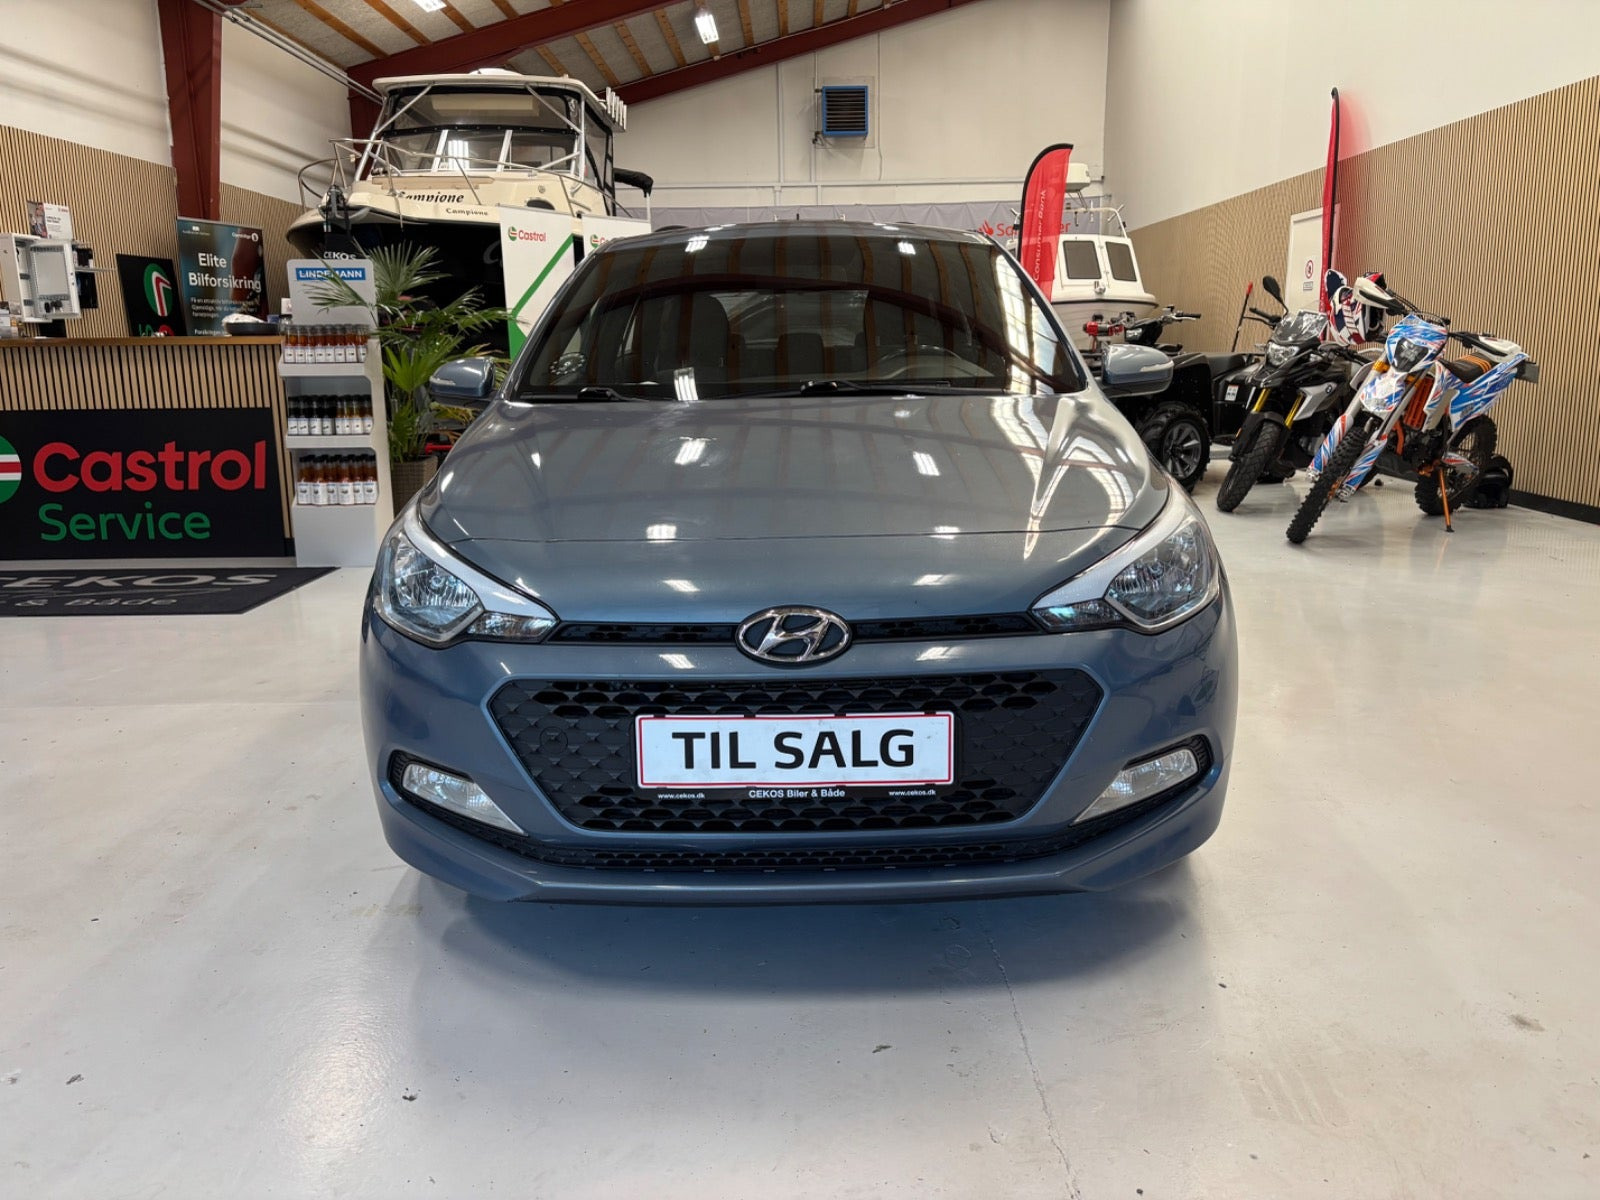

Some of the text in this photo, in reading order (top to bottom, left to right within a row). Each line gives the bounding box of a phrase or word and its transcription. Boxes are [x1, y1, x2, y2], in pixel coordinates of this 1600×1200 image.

[518, 229, 546, 242] Castrol
[198, 252, 227, 268] Elite
[1033, 222, 1043, 281] Consumer
[188, 272, 261, 293] Bilforsikring
[33, 440, 266, 492] Castrol
[39, 501, 211, 541] Service
[0, 574, 277, 588] EKOS
[672, 729, 914, 769] TIL SALG
[748, 788, 845, 798] CEKOS Biler & Både
